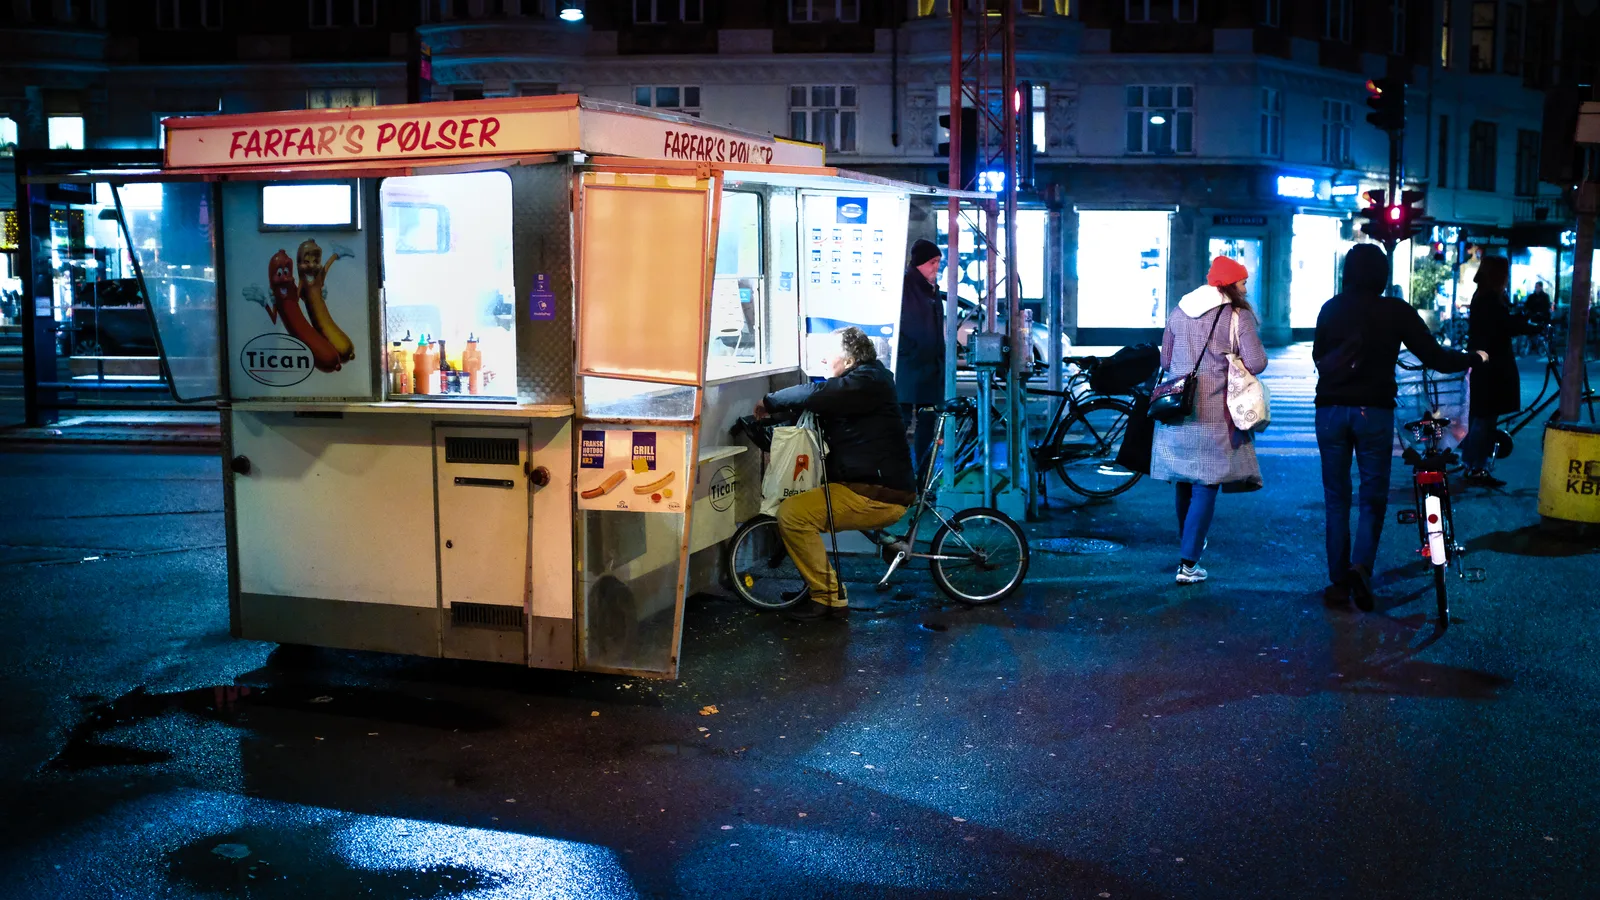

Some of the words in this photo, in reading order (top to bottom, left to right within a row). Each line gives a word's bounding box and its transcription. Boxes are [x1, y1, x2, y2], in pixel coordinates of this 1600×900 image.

[229, 123, 365, 159] FARFAR'S
[376, 116, 500, 153] PØLSER
[664, 130, 725, 162] FARFAR'S
[246, 351, 310, 369] Tican
[582, 440, 604, 448] FRANSK
[633, 445, 655, 455] GRILL
[711, 480, 741, 499] Tican
